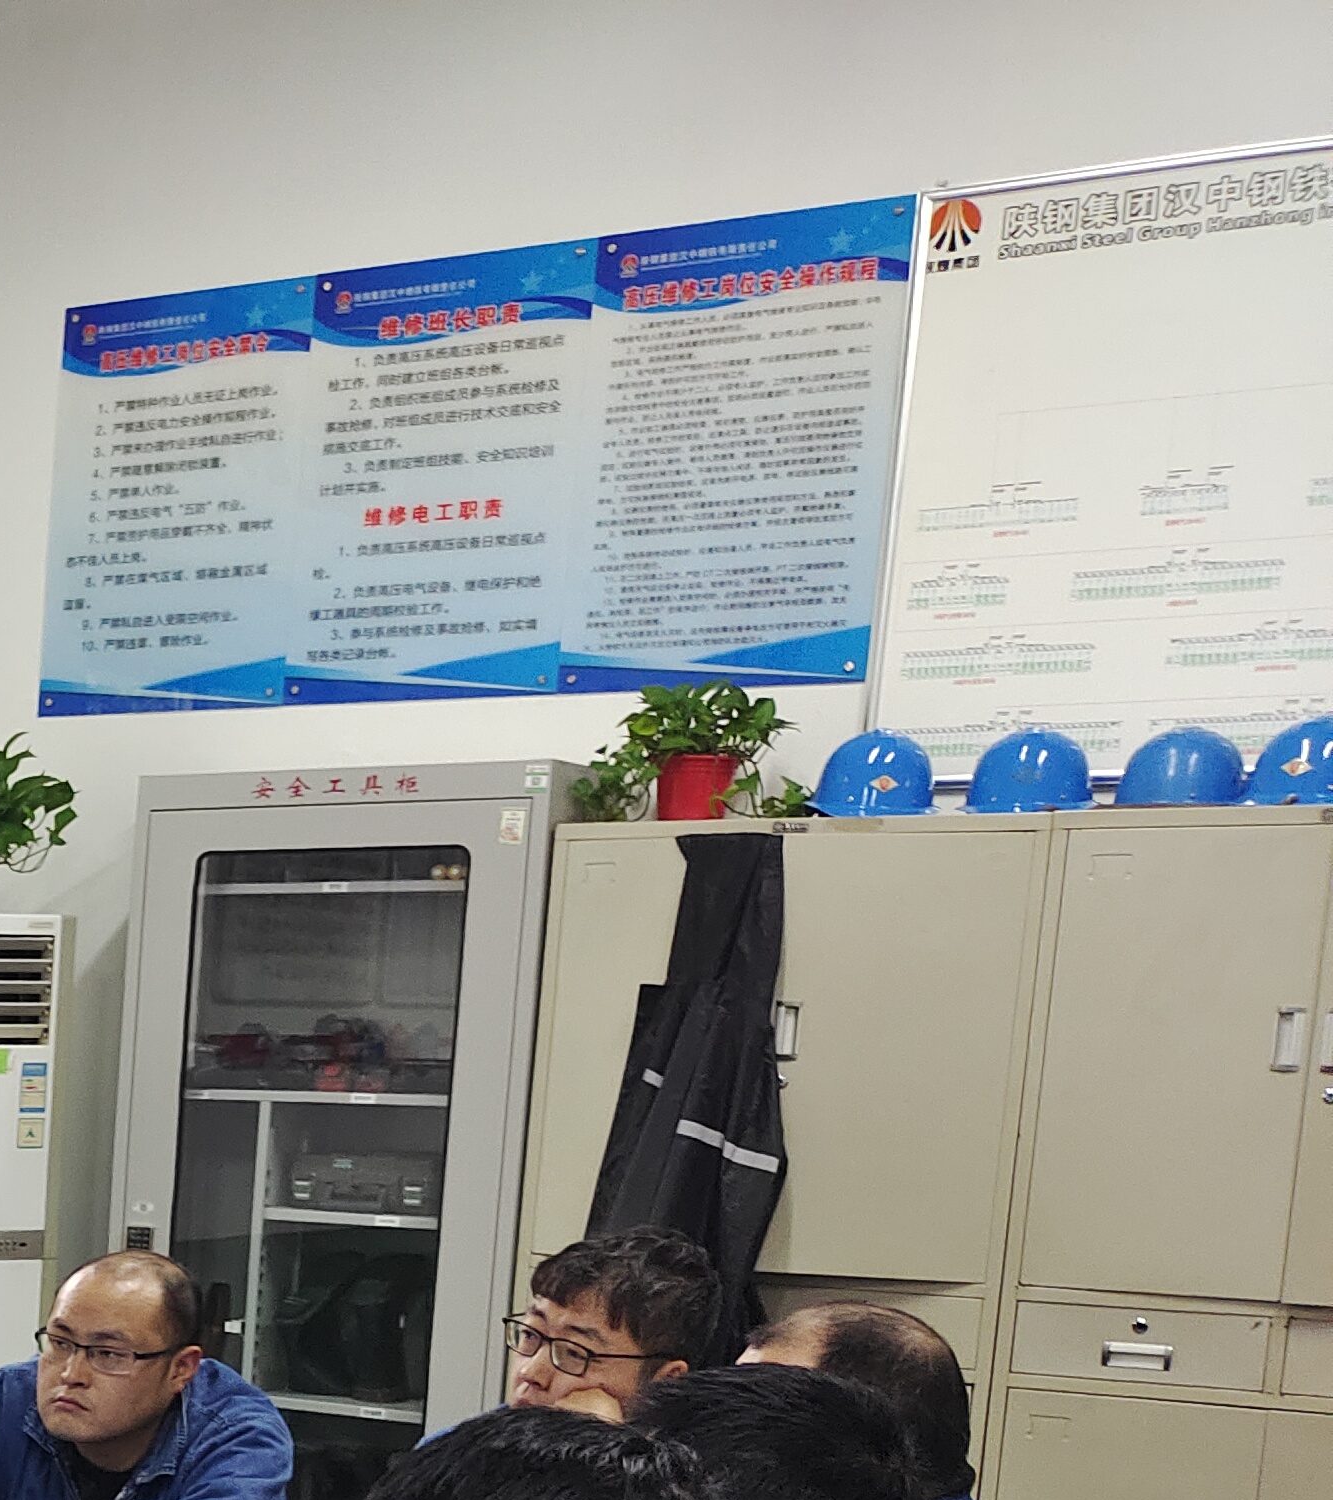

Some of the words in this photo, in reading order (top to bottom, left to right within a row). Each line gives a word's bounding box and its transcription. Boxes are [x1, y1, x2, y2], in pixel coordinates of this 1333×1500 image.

[1001, 162, 1333, 240] 陕钢集团汉中钢铁
[999, 234, 1077, 260] Shaanxi
[1081, 227, 1133, 249] Steel
[1137, 219, 1200, 242] Group
[1205, 209, 1314, 233] Hanzhong
[623, 257, 879, 311] 高压维修工岗位安全操作规程
[379, 302, 522, 340] 维修班长职责
[363, 498, 504, 527] 维修电工职责
[251, 770, 420, 799] 安全工具柜
